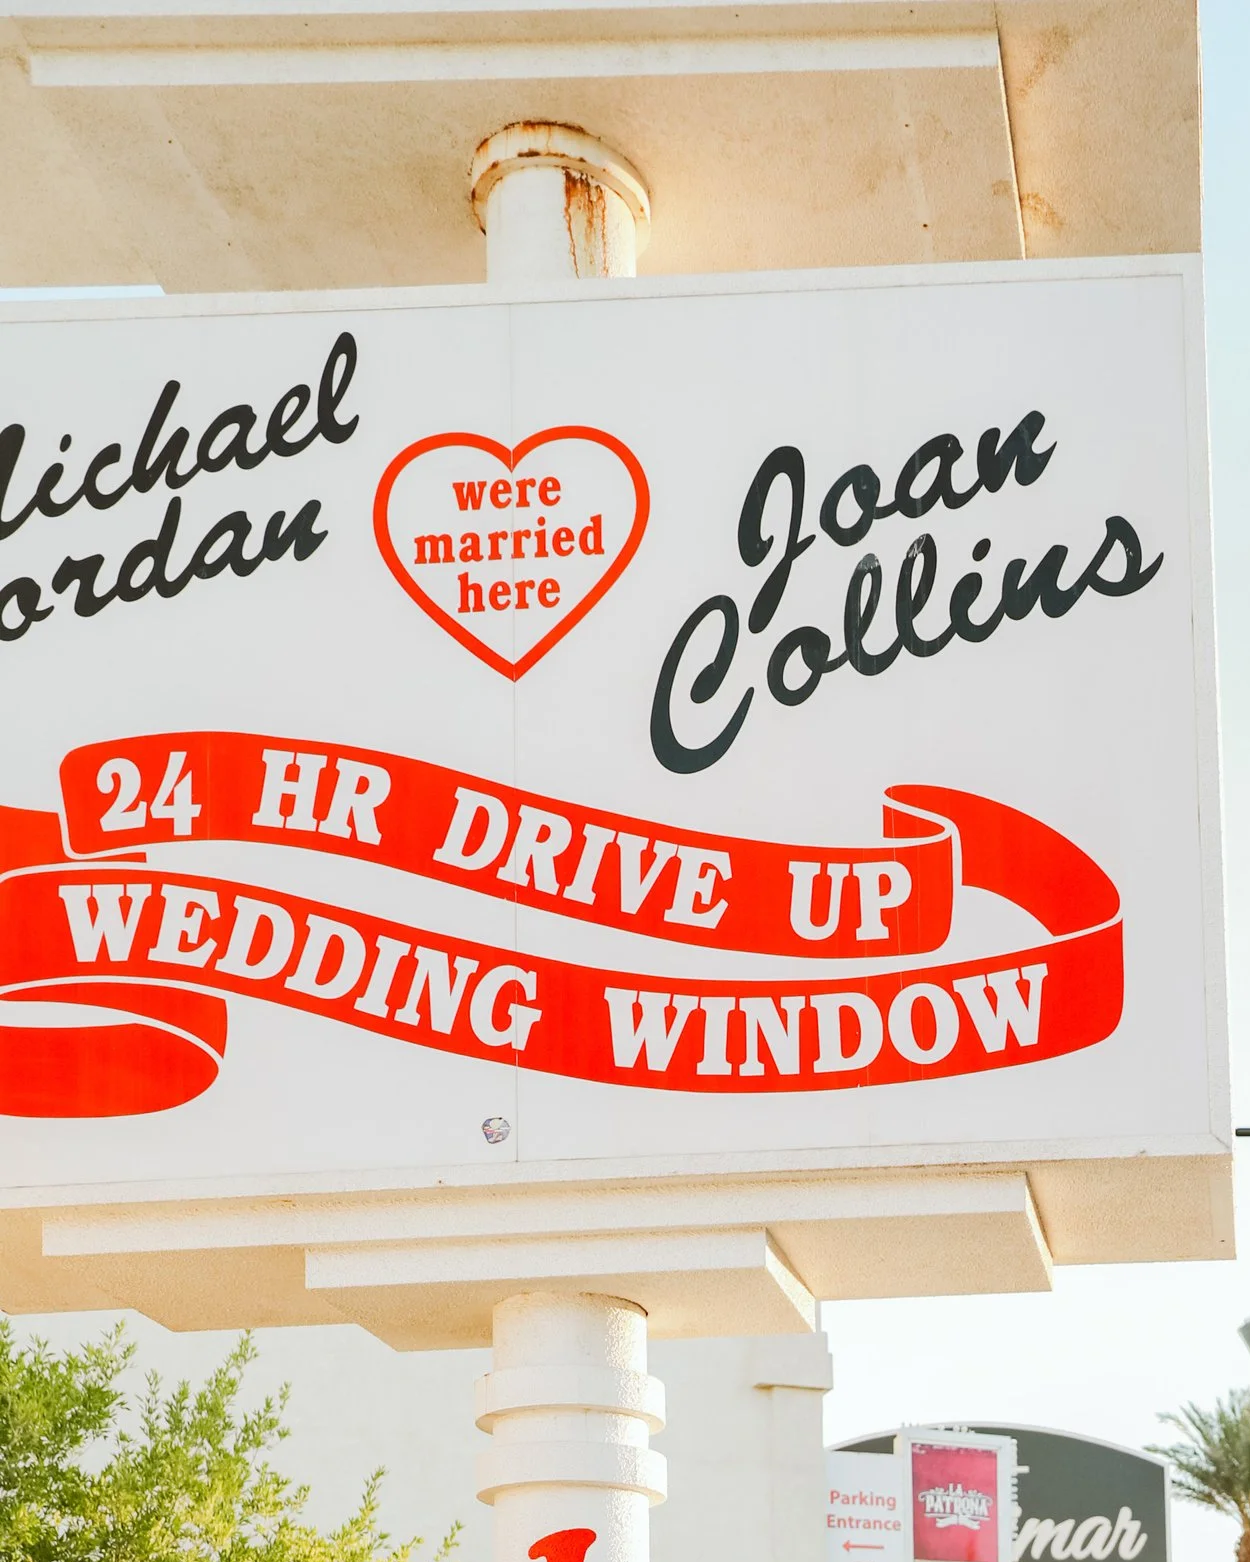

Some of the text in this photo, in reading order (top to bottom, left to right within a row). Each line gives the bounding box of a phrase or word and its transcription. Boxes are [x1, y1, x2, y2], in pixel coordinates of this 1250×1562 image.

[453, 476, 561, 511] were
[414, 514, 605, 564] married
[738, 410, 1057, 633] Joan
[0, 495, 329, 642] ordan
[457, 572, 561, 613] here
[650, 516, 1164, 774] Collins
[96, 749, 912, 941] 24 HR DRIVE UP
[58, 883, 1048, 1076] WEDDING WINDOW
[826, 1513, 902, 1531] Entrance
[829, 1489, 897, 1511] Parking
[1014, 1506, 1148, 1560] mar
